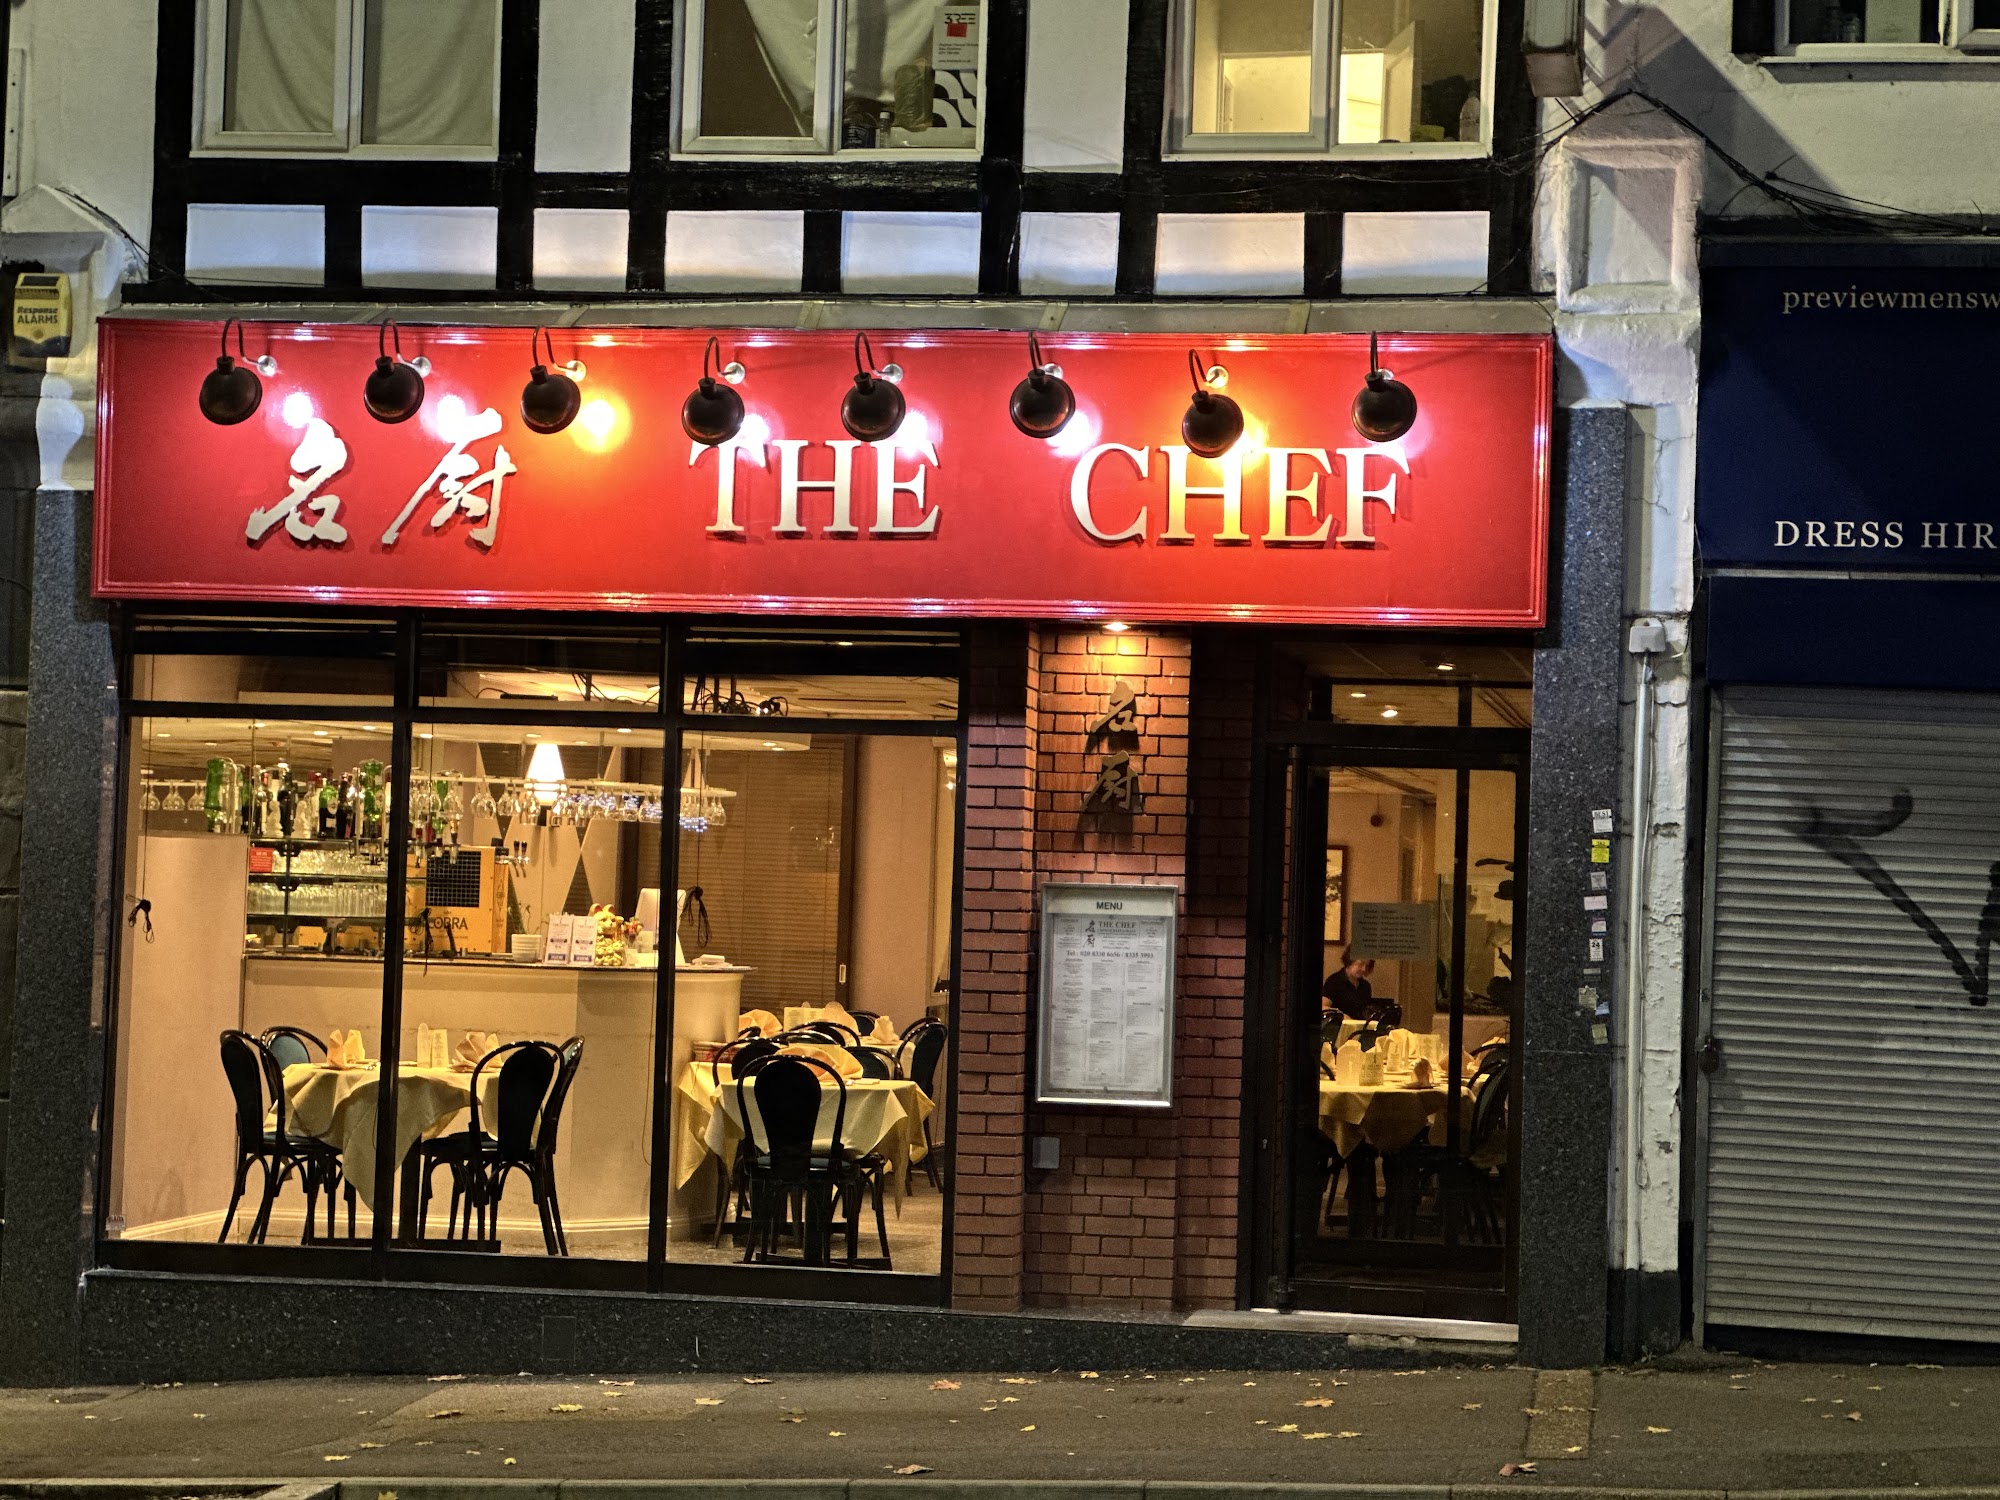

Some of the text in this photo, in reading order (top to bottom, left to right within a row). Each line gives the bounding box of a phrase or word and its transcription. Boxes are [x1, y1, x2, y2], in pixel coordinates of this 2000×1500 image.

[1782, 285, 2000, 314] previewmensw
[17, 315, 58, 324] ALARMS
[688, 438, 1411, 540] THE CHEF
[1774, 521, 1998, 549] DRESS HIR
[1096, 902, 1123, 910] MENU
[1115, 921, 1136, 929] CHEF
